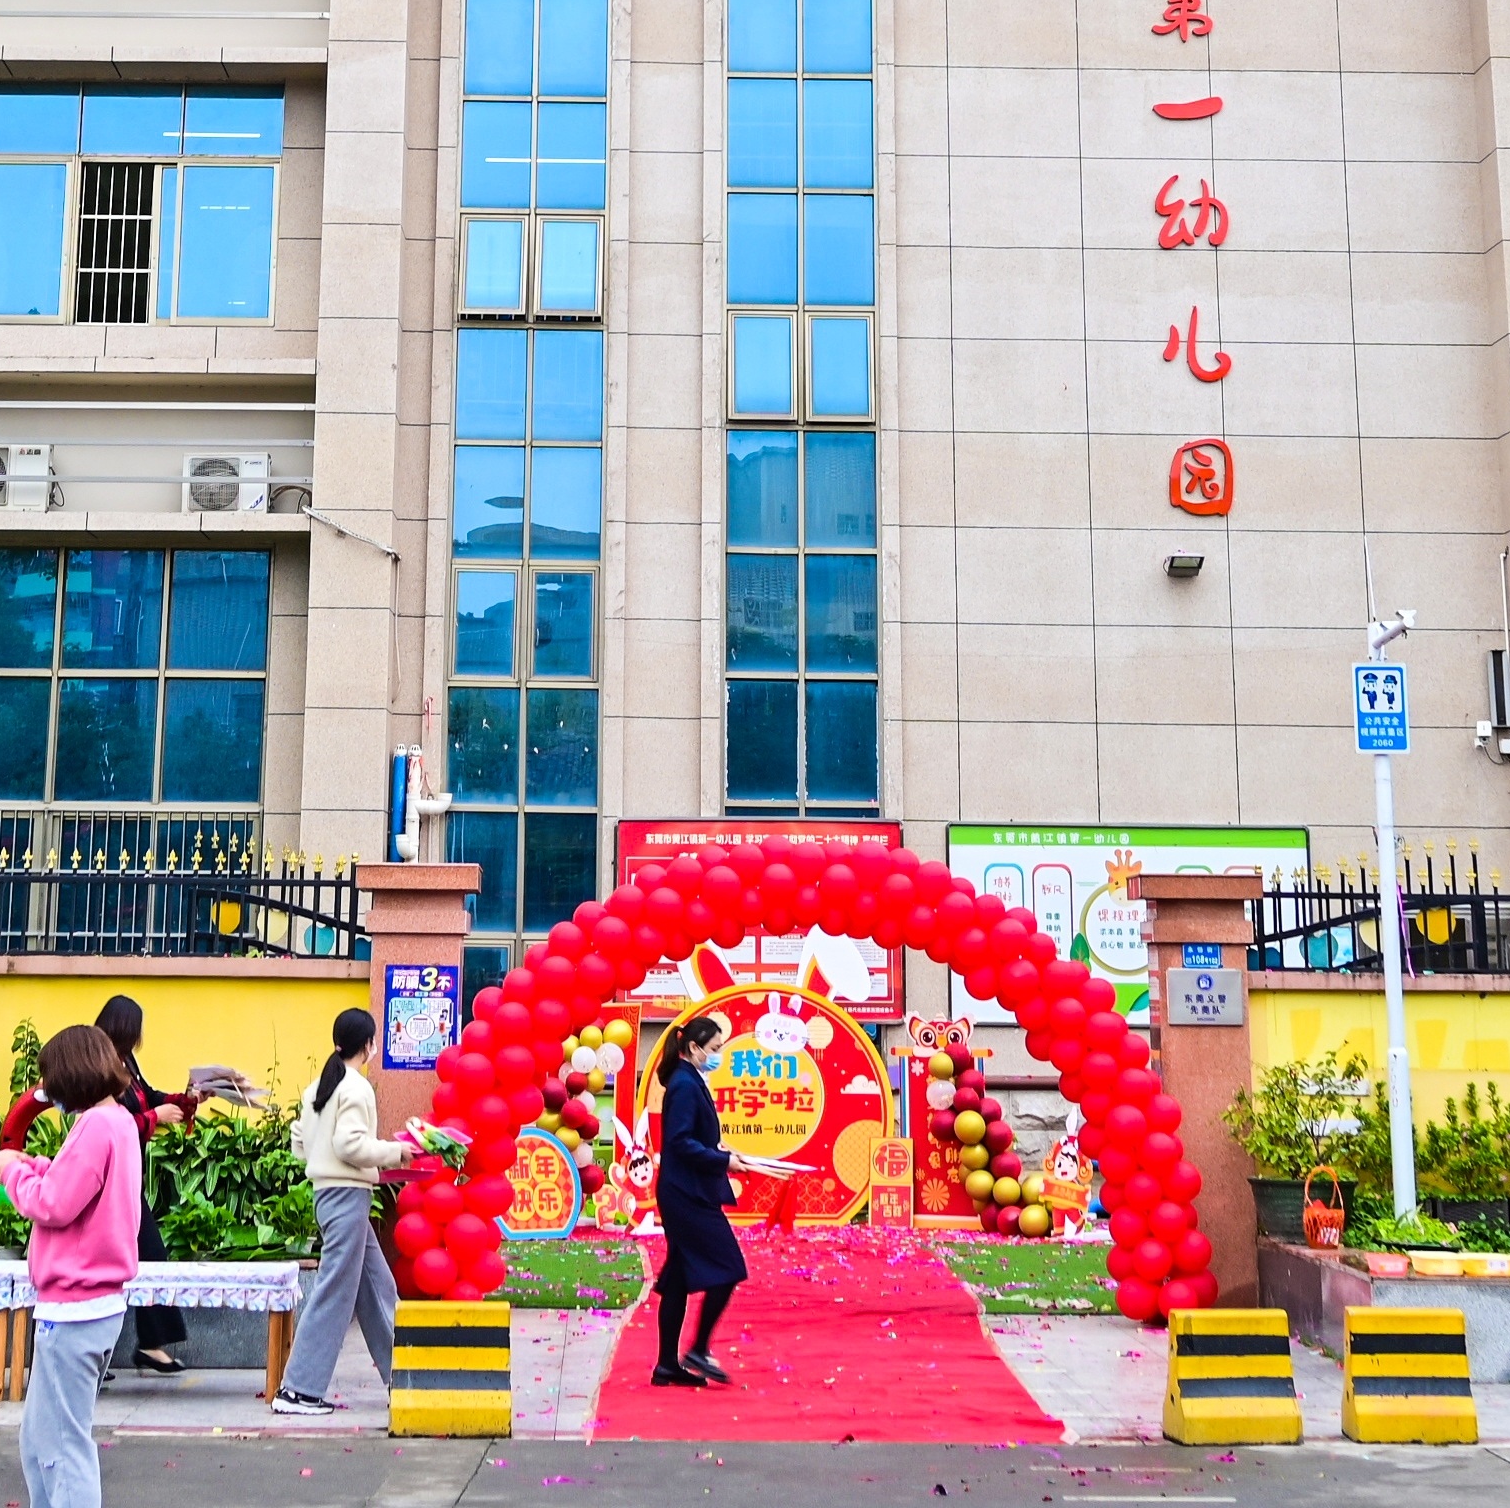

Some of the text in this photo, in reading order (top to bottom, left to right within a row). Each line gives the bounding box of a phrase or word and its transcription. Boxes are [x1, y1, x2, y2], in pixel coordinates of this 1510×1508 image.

[1364, 716, 1400, 726] 公共安全
[993, 832, 1130, 845] 东莞市黄江镇第一幼儿园
[730, 1049, 798, 1079] 我们
[713, 1080, 815, 1118] 开学啦
[874, 1141, 911, 1179] 福
